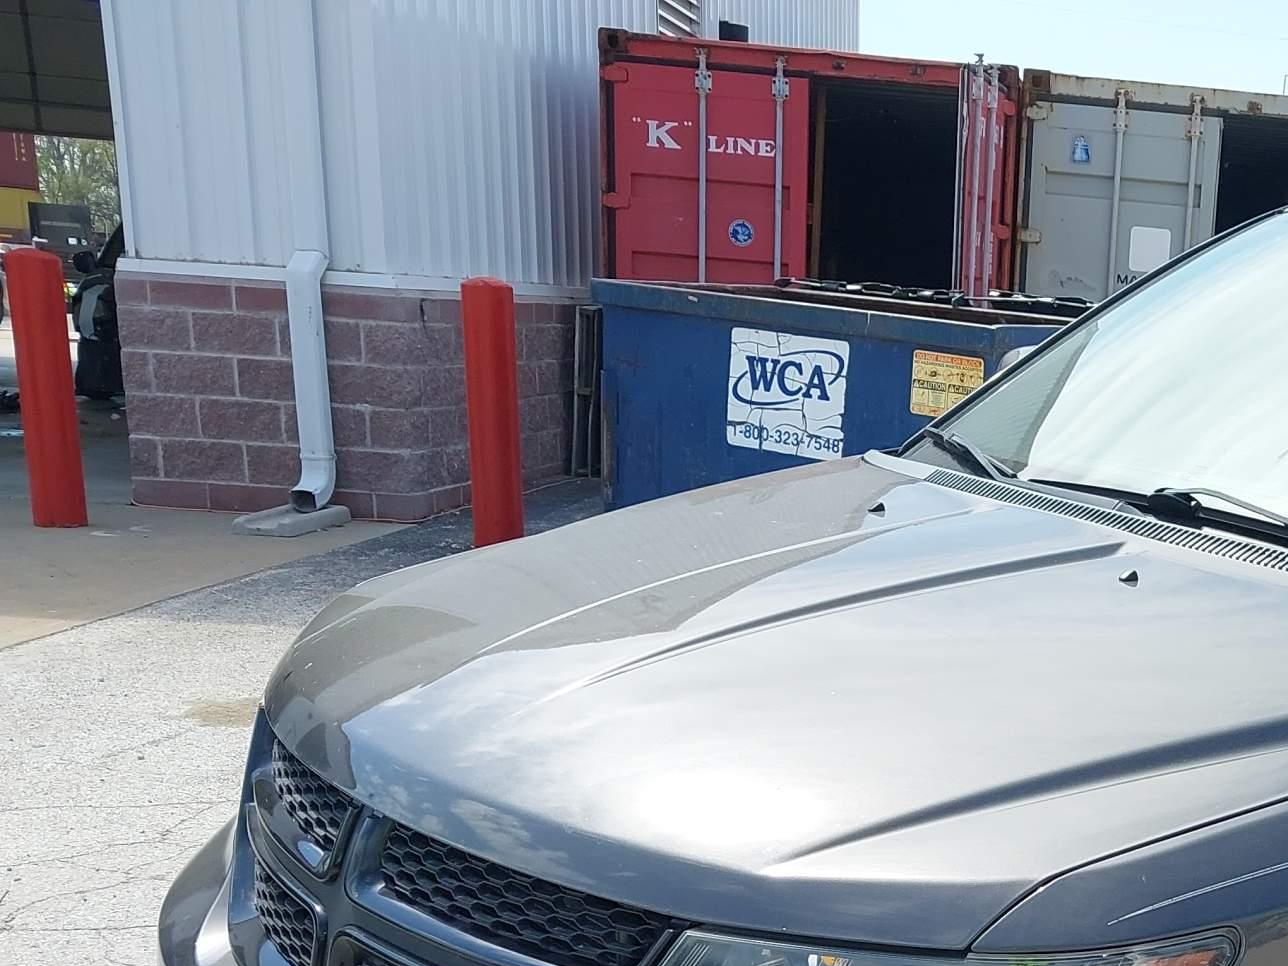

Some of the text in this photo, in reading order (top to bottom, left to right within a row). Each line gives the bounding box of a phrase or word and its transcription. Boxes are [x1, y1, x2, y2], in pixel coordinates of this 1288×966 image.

[706, 135, 776, 158] LINE
[745, 355, 831, 401] WCA
[918, 380, 946, 391] CAUTION
[732, 423, 840, 454] 1-800-323-7548
